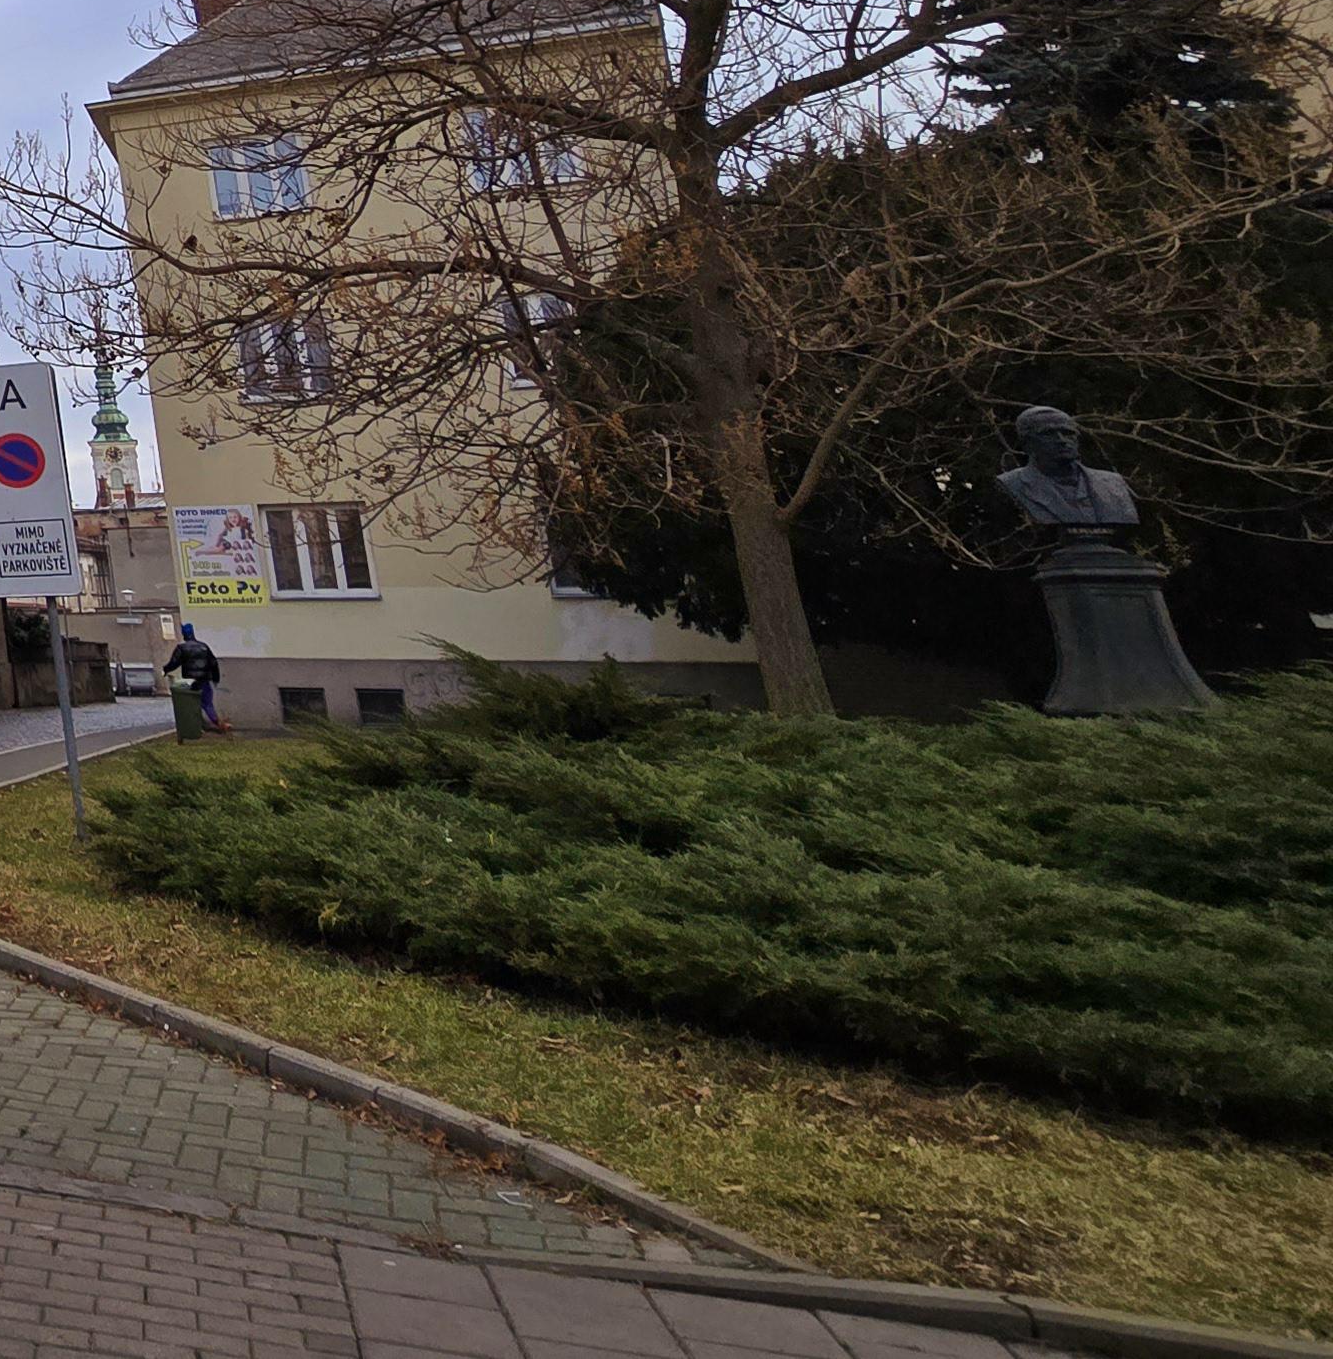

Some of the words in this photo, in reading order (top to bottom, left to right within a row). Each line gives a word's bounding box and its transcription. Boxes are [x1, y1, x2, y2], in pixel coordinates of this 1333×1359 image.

[175, 509, 199, 517] FOTO
[14, 525, 45, 539] MIMO
[1, 538, 63, 556] VYZNAČENÉ
[2, 555, 67, 573] PARKOVIŠTĚ
[186, 581, 230, 595] Foto
[236, 580, 261, 595] Pv
